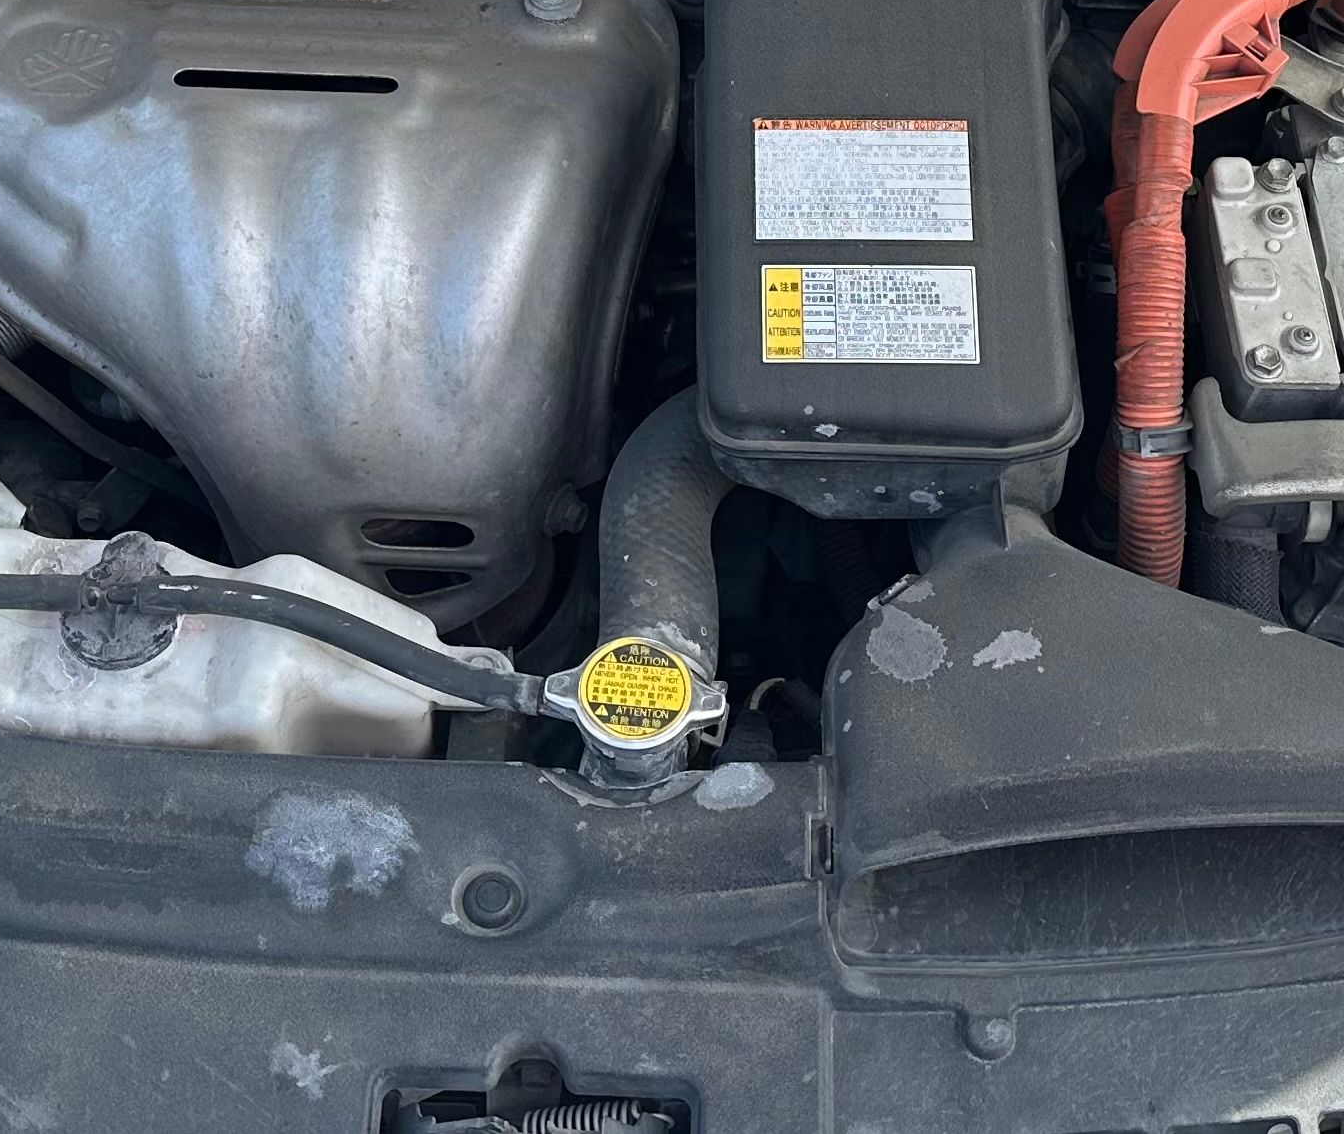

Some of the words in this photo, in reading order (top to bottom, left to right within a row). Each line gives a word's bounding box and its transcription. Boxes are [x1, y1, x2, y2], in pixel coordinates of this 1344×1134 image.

[795, 121, 836, 130] WARNING
[839, 121, 910, 131] AVERTISSEMENT
[767, 308, 801, 318] CAUTION
[768, 327, 801, 337] ATTENTION
[619, 654, 669, 666] CAUTION
[616, 706, 669, 719] ATTENTION
